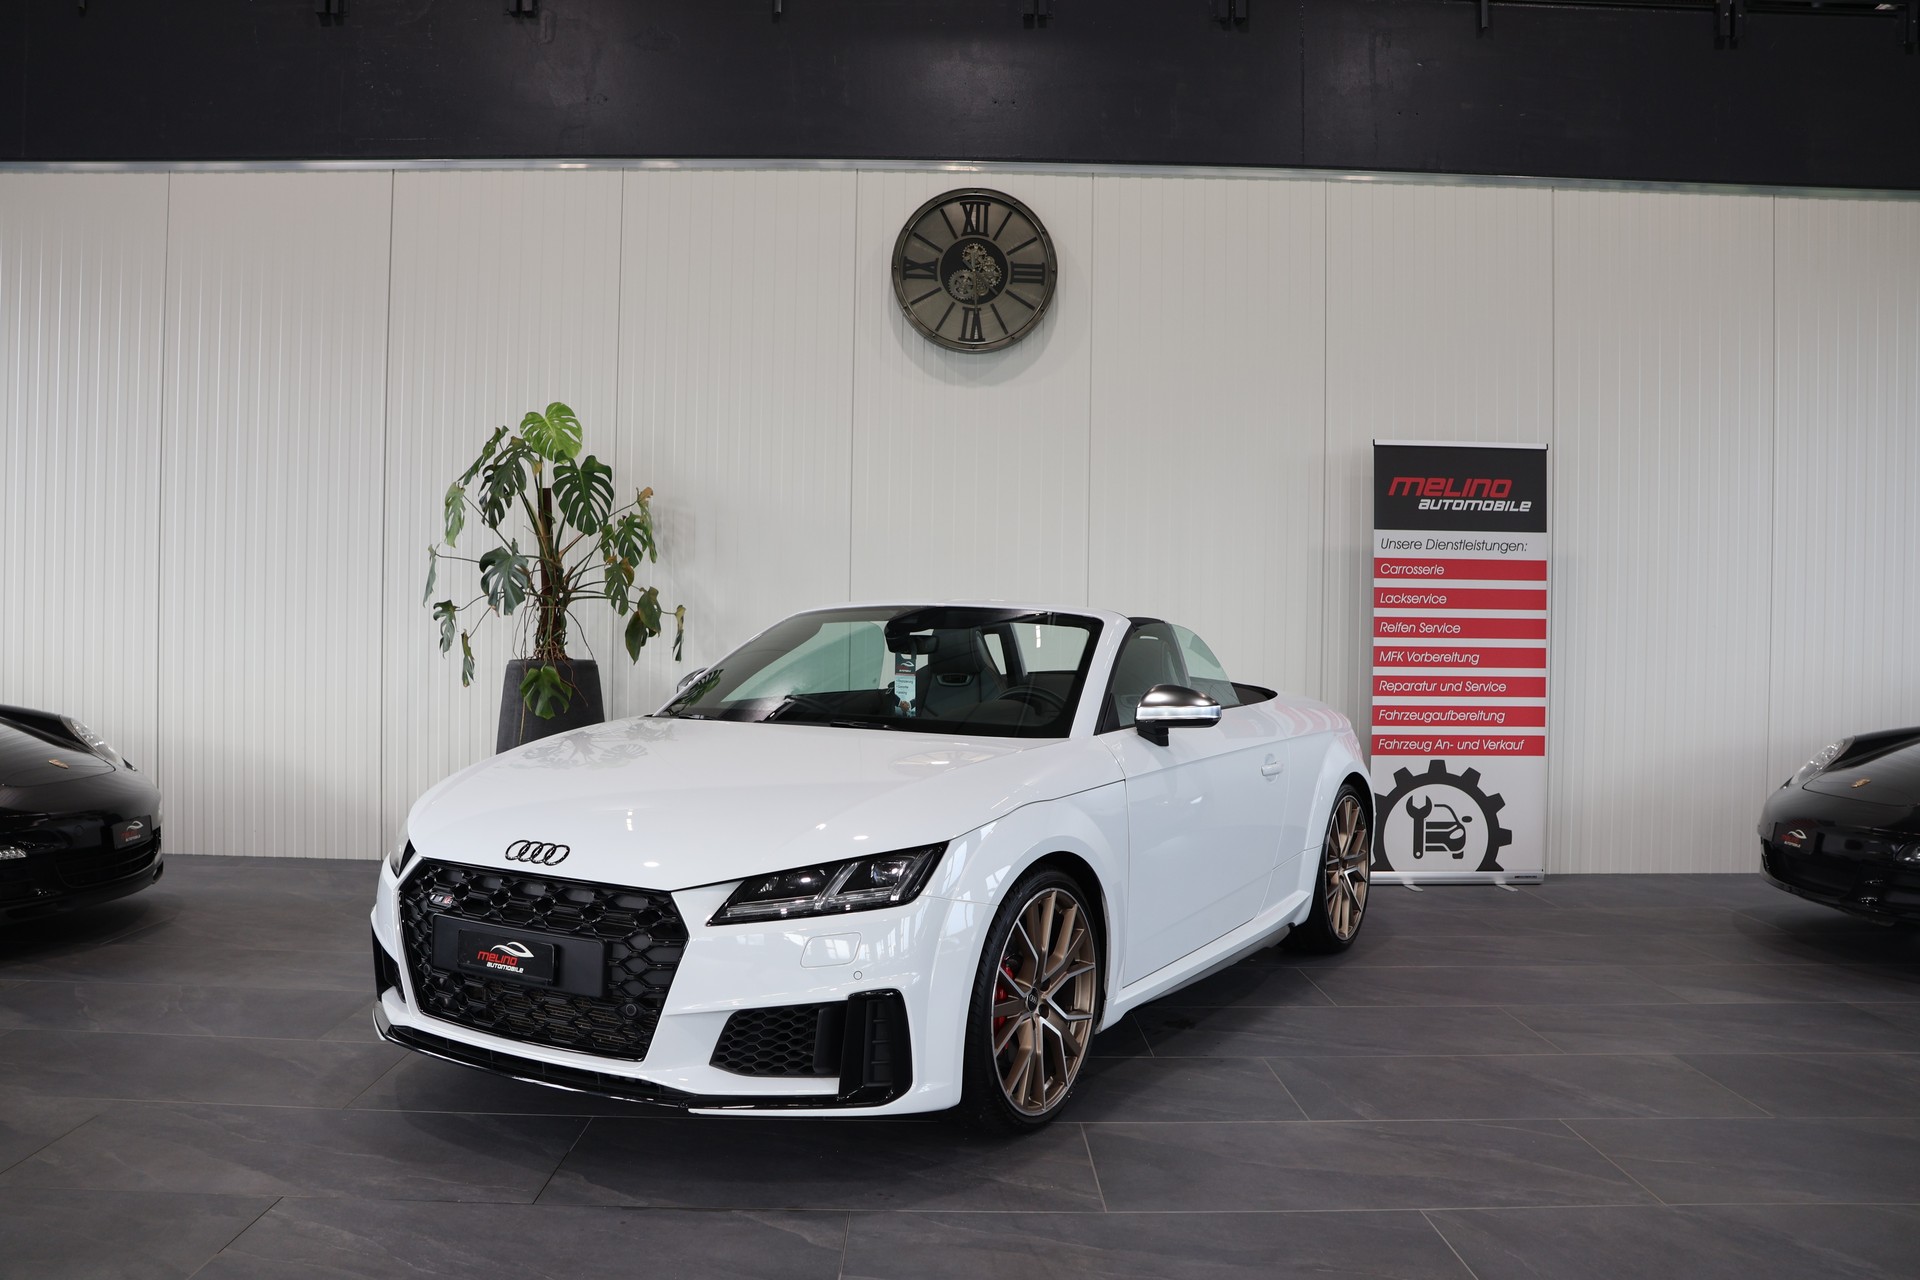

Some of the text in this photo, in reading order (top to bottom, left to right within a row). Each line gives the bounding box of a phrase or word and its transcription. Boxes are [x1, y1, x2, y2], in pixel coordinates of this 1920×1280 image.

[960, 201, 991, 238] XII
[1388, 477, 1513, 498] MELINO
[1418, 498, 1532, 512] AUTOMOBILE
[1380, 538, 1528, 554] Unsere Dienstleistungen:
[1380, 563, 1445, 576] Carrosserie
[1380, 592, 1447, 605] Lackservice
[1379, 621, 1461, 634] Reifen Service
[1379, 651, 1480, 665] MFK Vorbereitung
[1379, 680, 1507, 693] Reparatur und Service
[1378, 709, 1506, 724] Fahrzeugaufbereitung
[1378, 739, 1525, 752] Fahrzeug An- und Verkauf
[477, 950, 518, 967] MELINO
